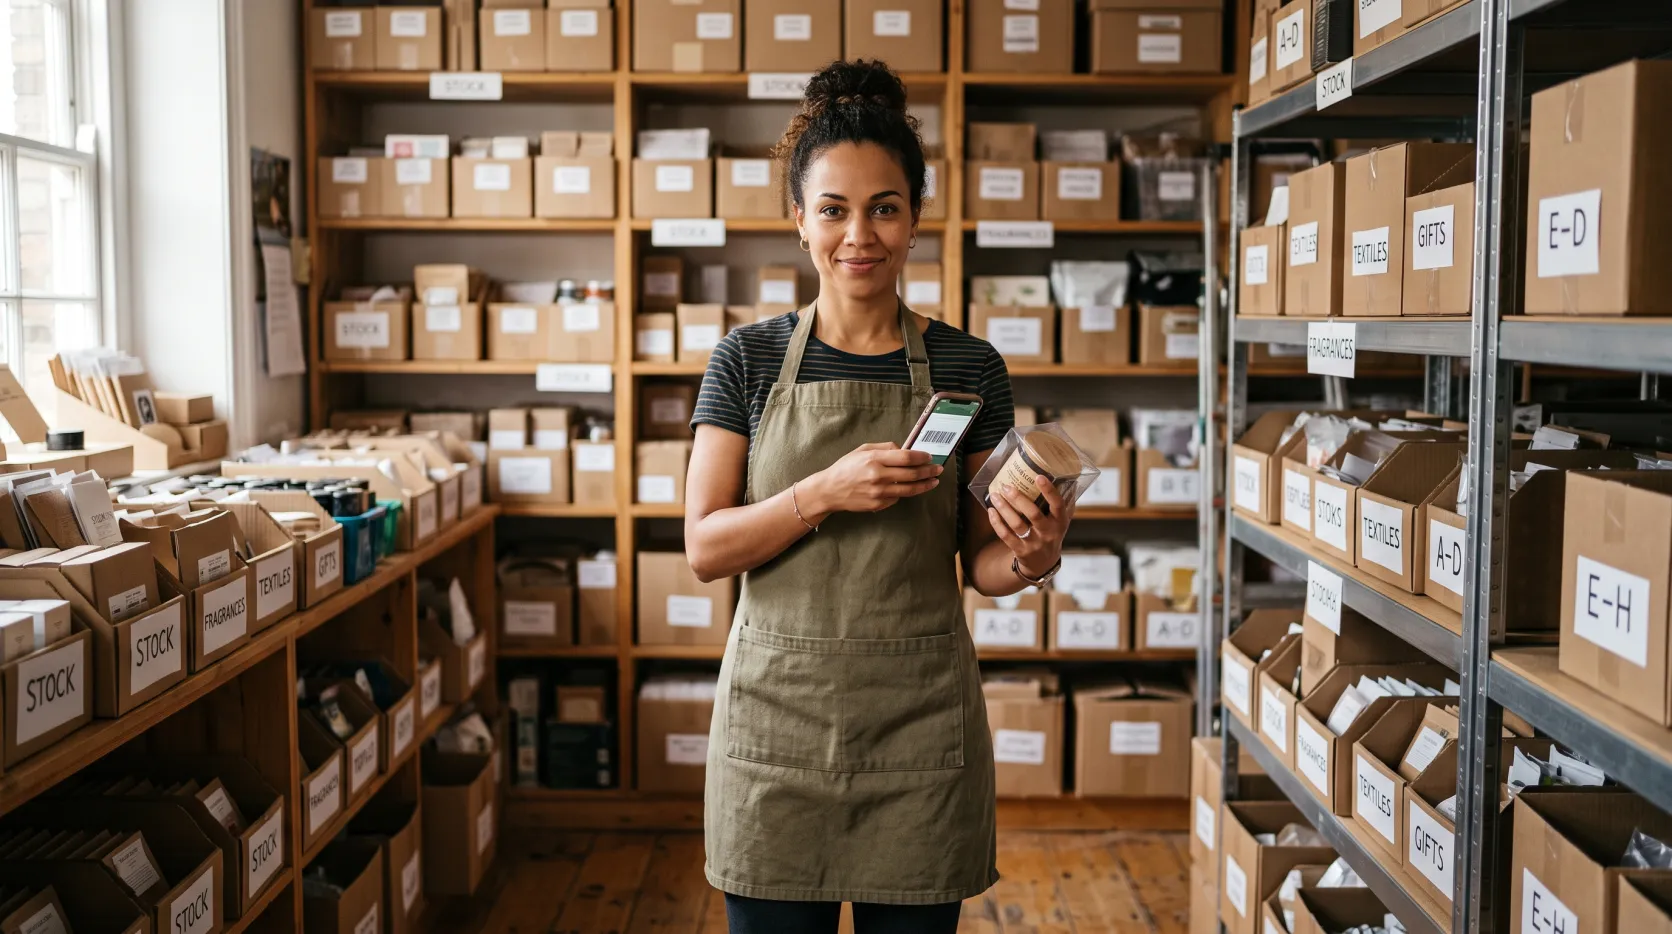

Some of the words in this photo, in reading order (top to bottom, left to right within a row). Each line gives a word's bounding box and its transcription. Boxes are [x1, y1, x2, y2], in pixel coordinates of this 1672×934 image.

[1278, 22, 1300, 54] A-D
[1322, 70, 1346, 98] STOCK
[1418, 221, 1446, 248] GIFTS
[1549, 208, 1587, 249] E-D
[1353, 241, 1388, 264] TEXTILES
[1309, 337, 1354, 360] FRAGRANCES
[1318, 498, 1342, 528] STOKS
[1364, 516, 1400, 549] TEXTILES
[318, 550, 337, 578] GIFTS
[1436, 536, 1462, 576] A-D
[258, 566, 291, 598] TEXTILES
[204, 597, 246, 631] FRAGRANCES
[1587, 573, 1633, 634] E-H
[136, 624, 174, 667] STOCK
[1157, 621, 1195, 639] A-D
[26, 664, 76, 713] STOCK
[1359, 775, 1392, 818] TEXTILES
[252, 828, 278, 873] STOCK
[1414, 825, 1445, 872] GIFTS
[175, 887, 209, 934] STOCK
